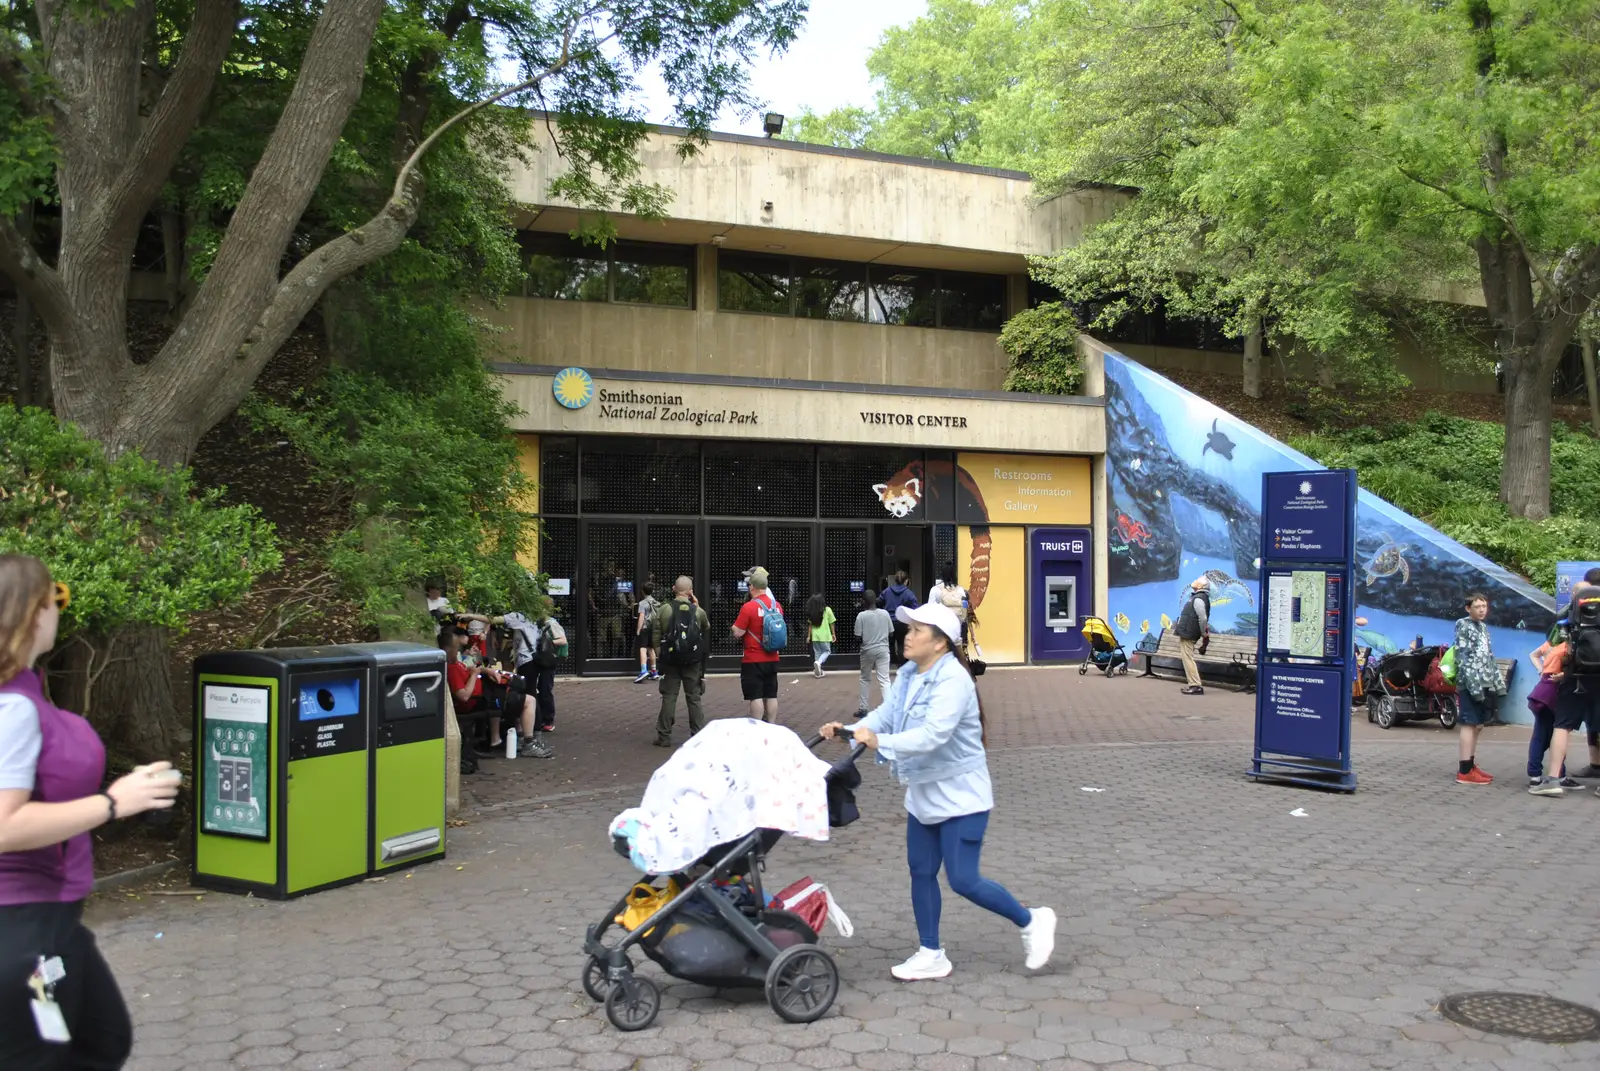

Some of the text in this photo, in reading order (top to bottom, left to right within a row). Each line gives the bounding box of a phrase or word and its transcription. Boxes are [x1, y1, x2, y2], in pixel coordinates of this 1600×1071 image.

[599, 388, 683, 406] Smithsonian
[599, 404, 759, 425] National Zoological Park
[860, 412, 968, 428] VISITOR CENTER
[994, 467, 1052, 481] Restrooms
[1018, 484, 1072, 497] Information
[1004, 500, 1038, 513] Gallery
[1040, 542, 1071, 551] TRUIST
[317, 732, 333, 741] GLASS
[316, 739, 337, 748] PLASTIC
